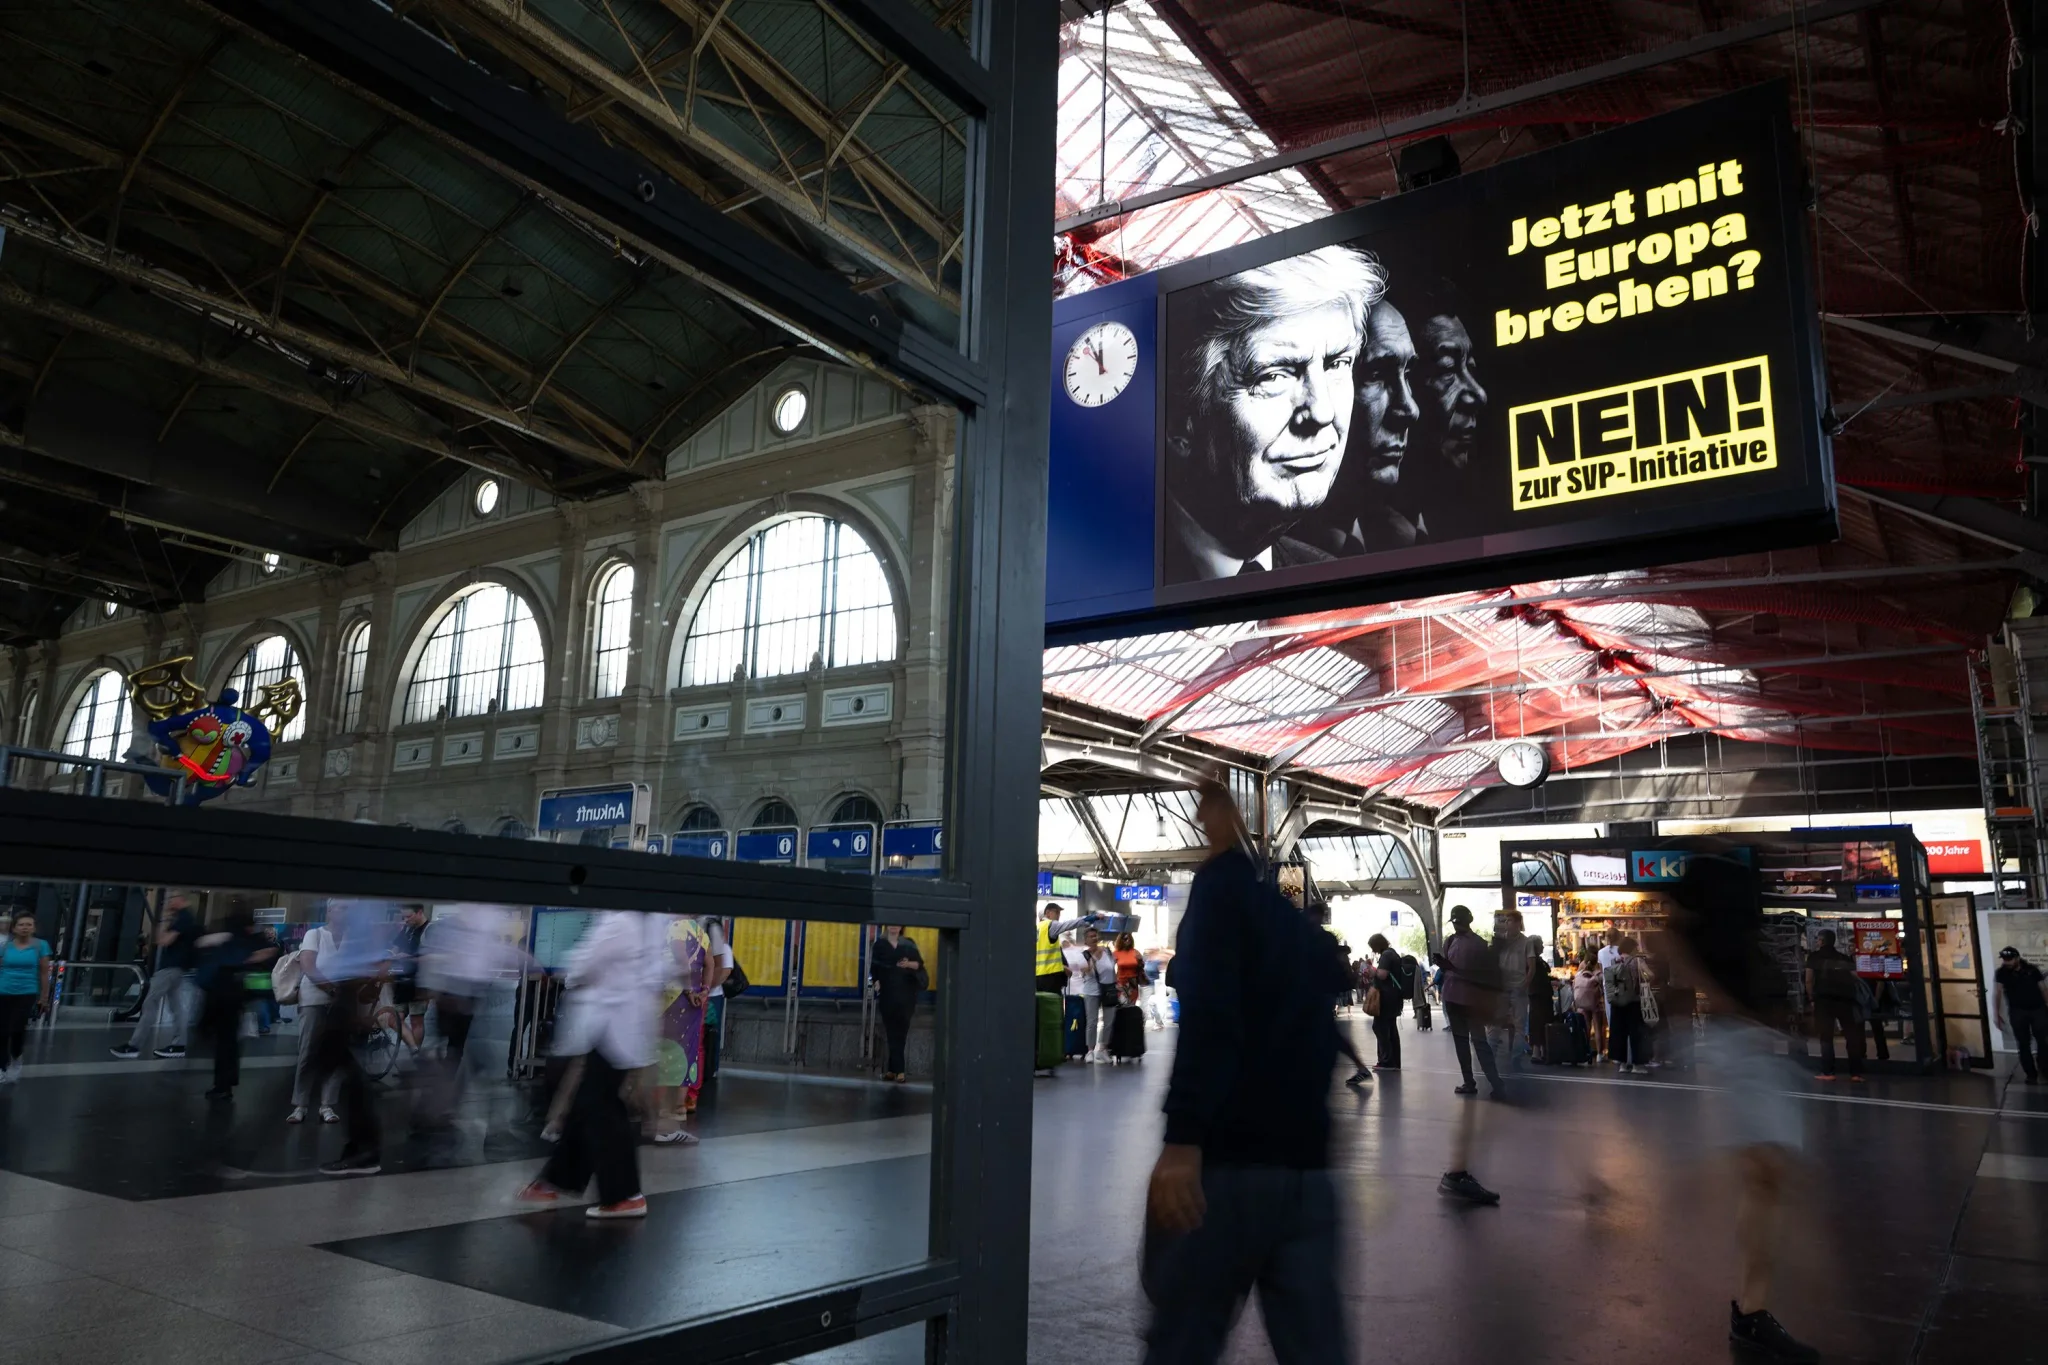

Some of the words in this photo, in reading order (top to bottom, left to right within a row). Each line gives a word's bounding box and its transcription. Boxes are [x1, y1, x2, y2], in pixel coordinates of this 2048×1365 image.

[1507, 189, 1636, 256] Jetzt
[1645, 158, 1744, 218] mit
[1544, 212, 1748, 290] Europa
[1495, 249, 1762, 347] brechen?
[1516, 364, 1765, 471] NEIN!
[1519, 474, 1562, 503] zur
[1566, 438, 1768, 495] SVP-Initiative
[1638, 857, 1656, 877] k
[1944, 845, 1970, 856] Jahre
